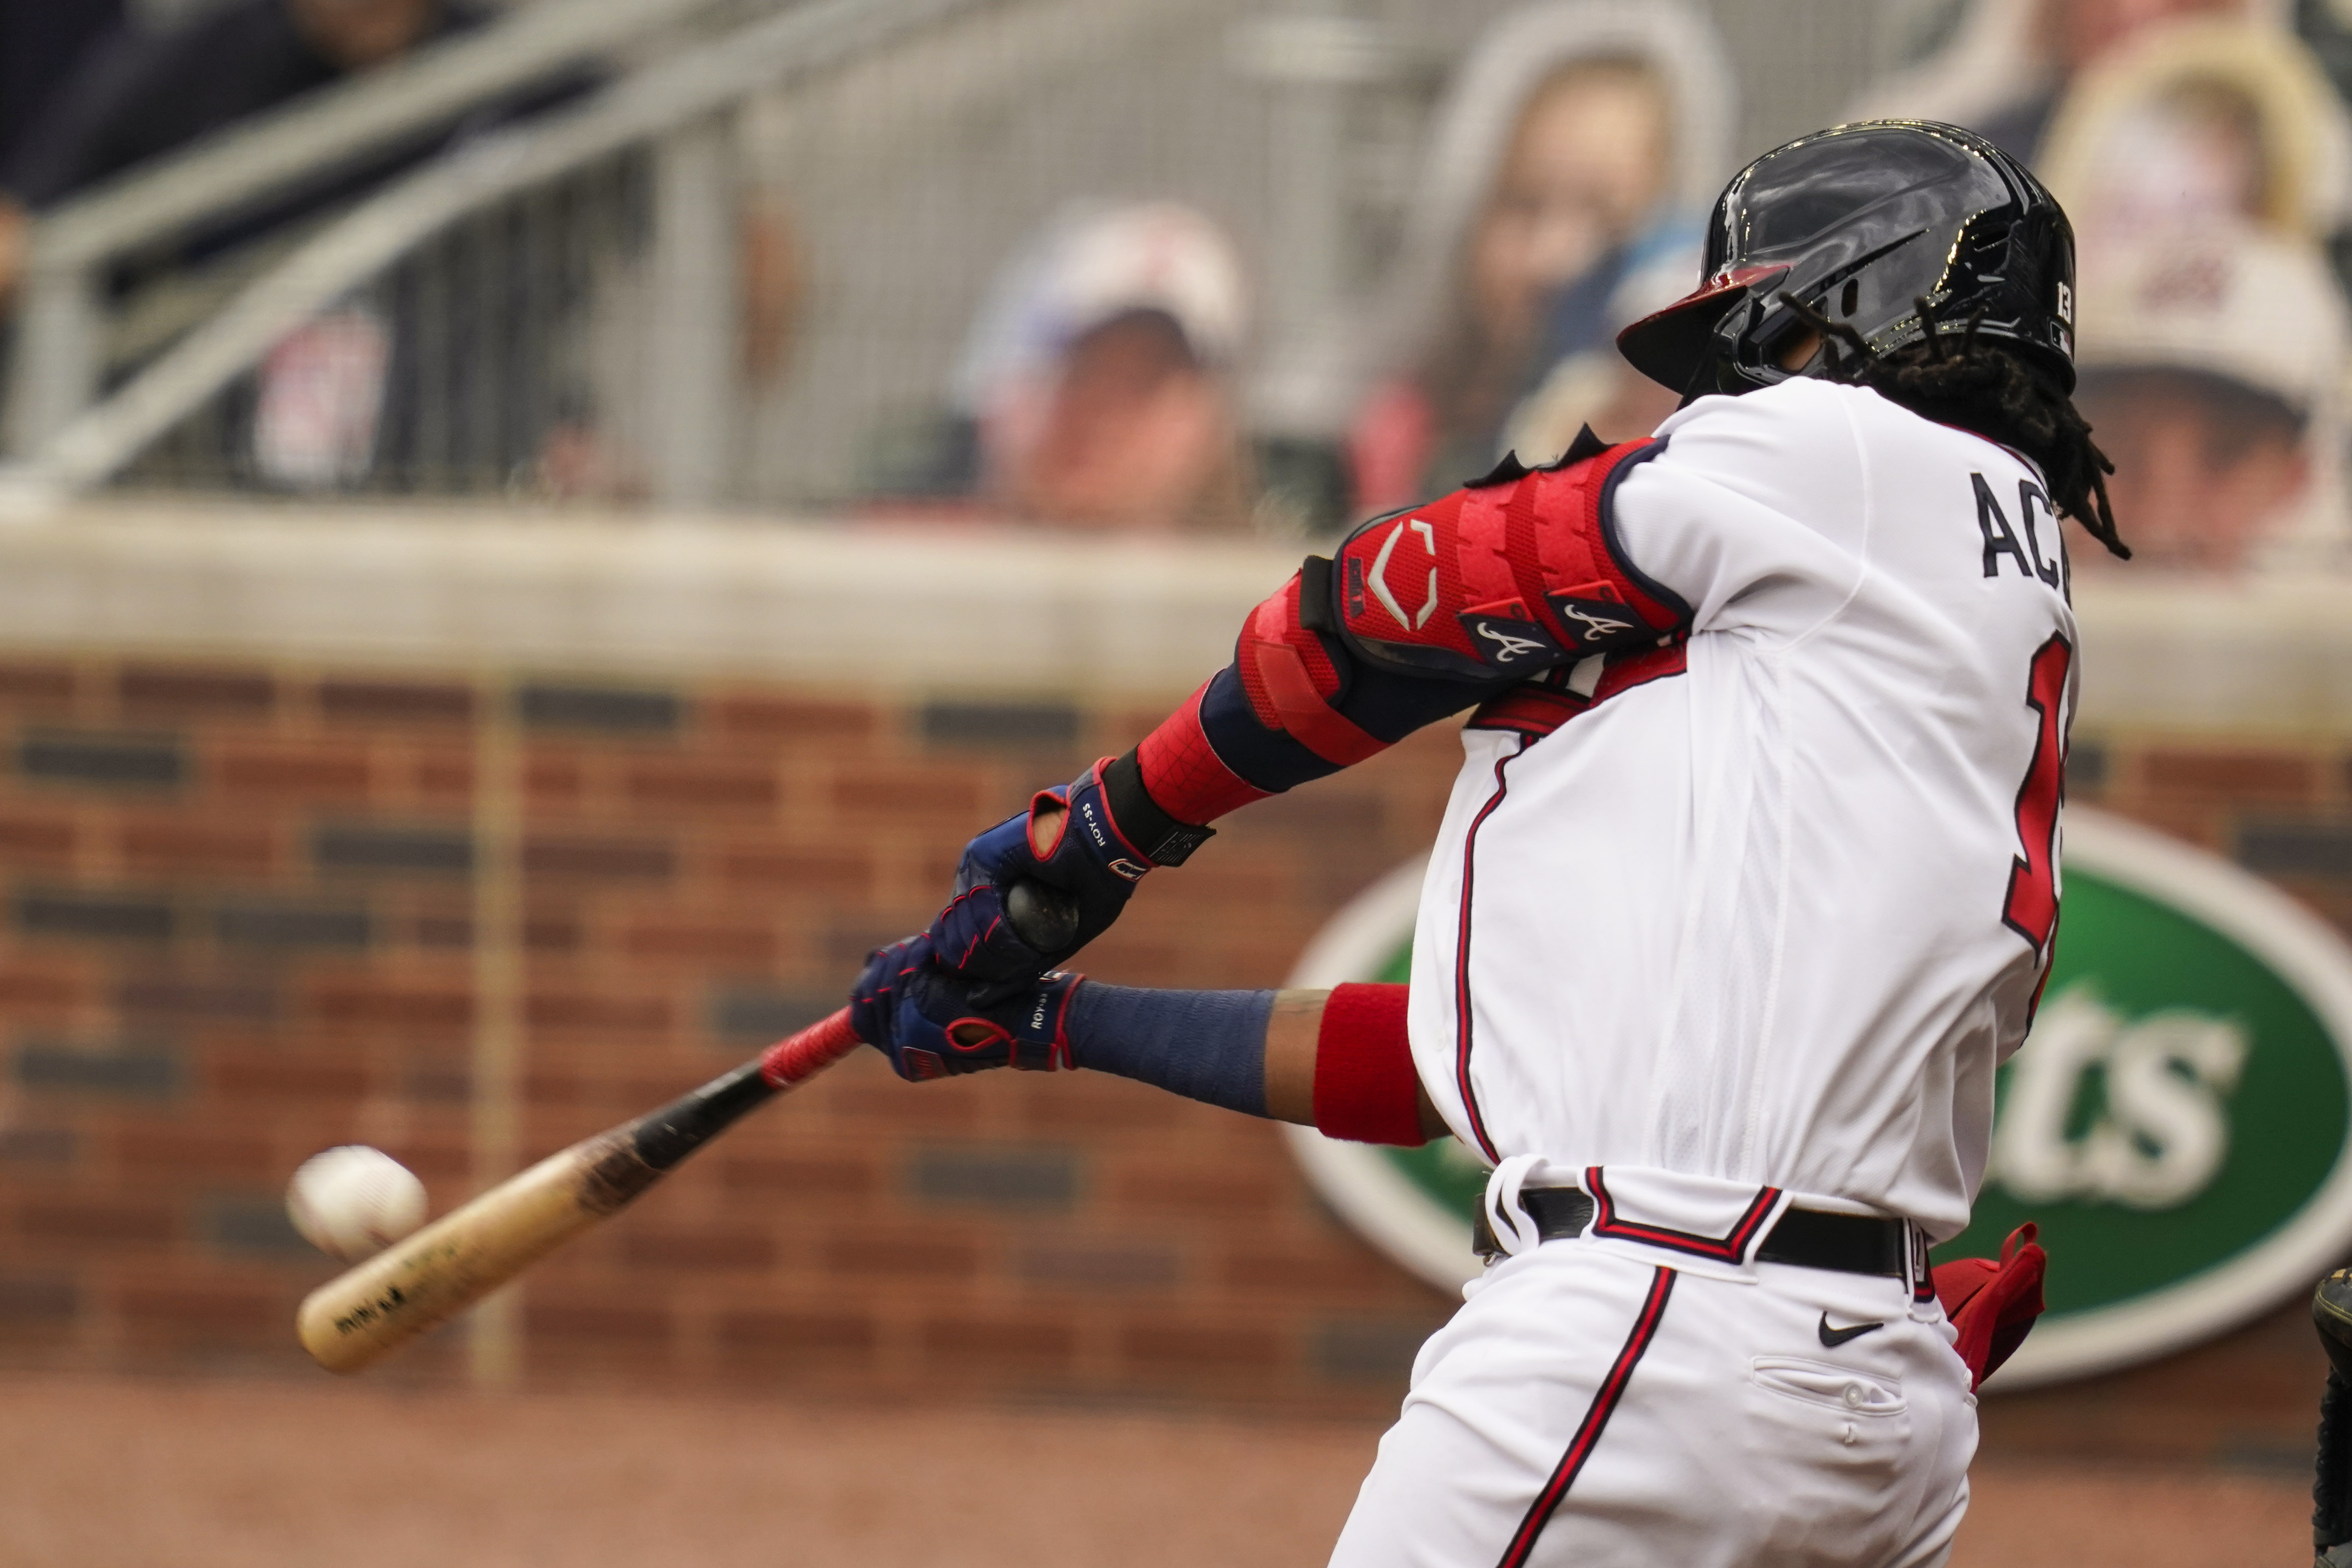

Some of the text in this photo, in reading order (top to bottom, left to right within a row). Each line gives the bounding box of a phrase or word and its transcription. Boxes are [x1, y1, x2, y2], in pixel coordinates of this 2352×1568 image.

[2058, 281, 2071, 325] 13
[1970, 472, 2070, 604] AC
[1082, 803, 1106, 846] ROY-SS
[2001, 629, 2071, 1015] 1
